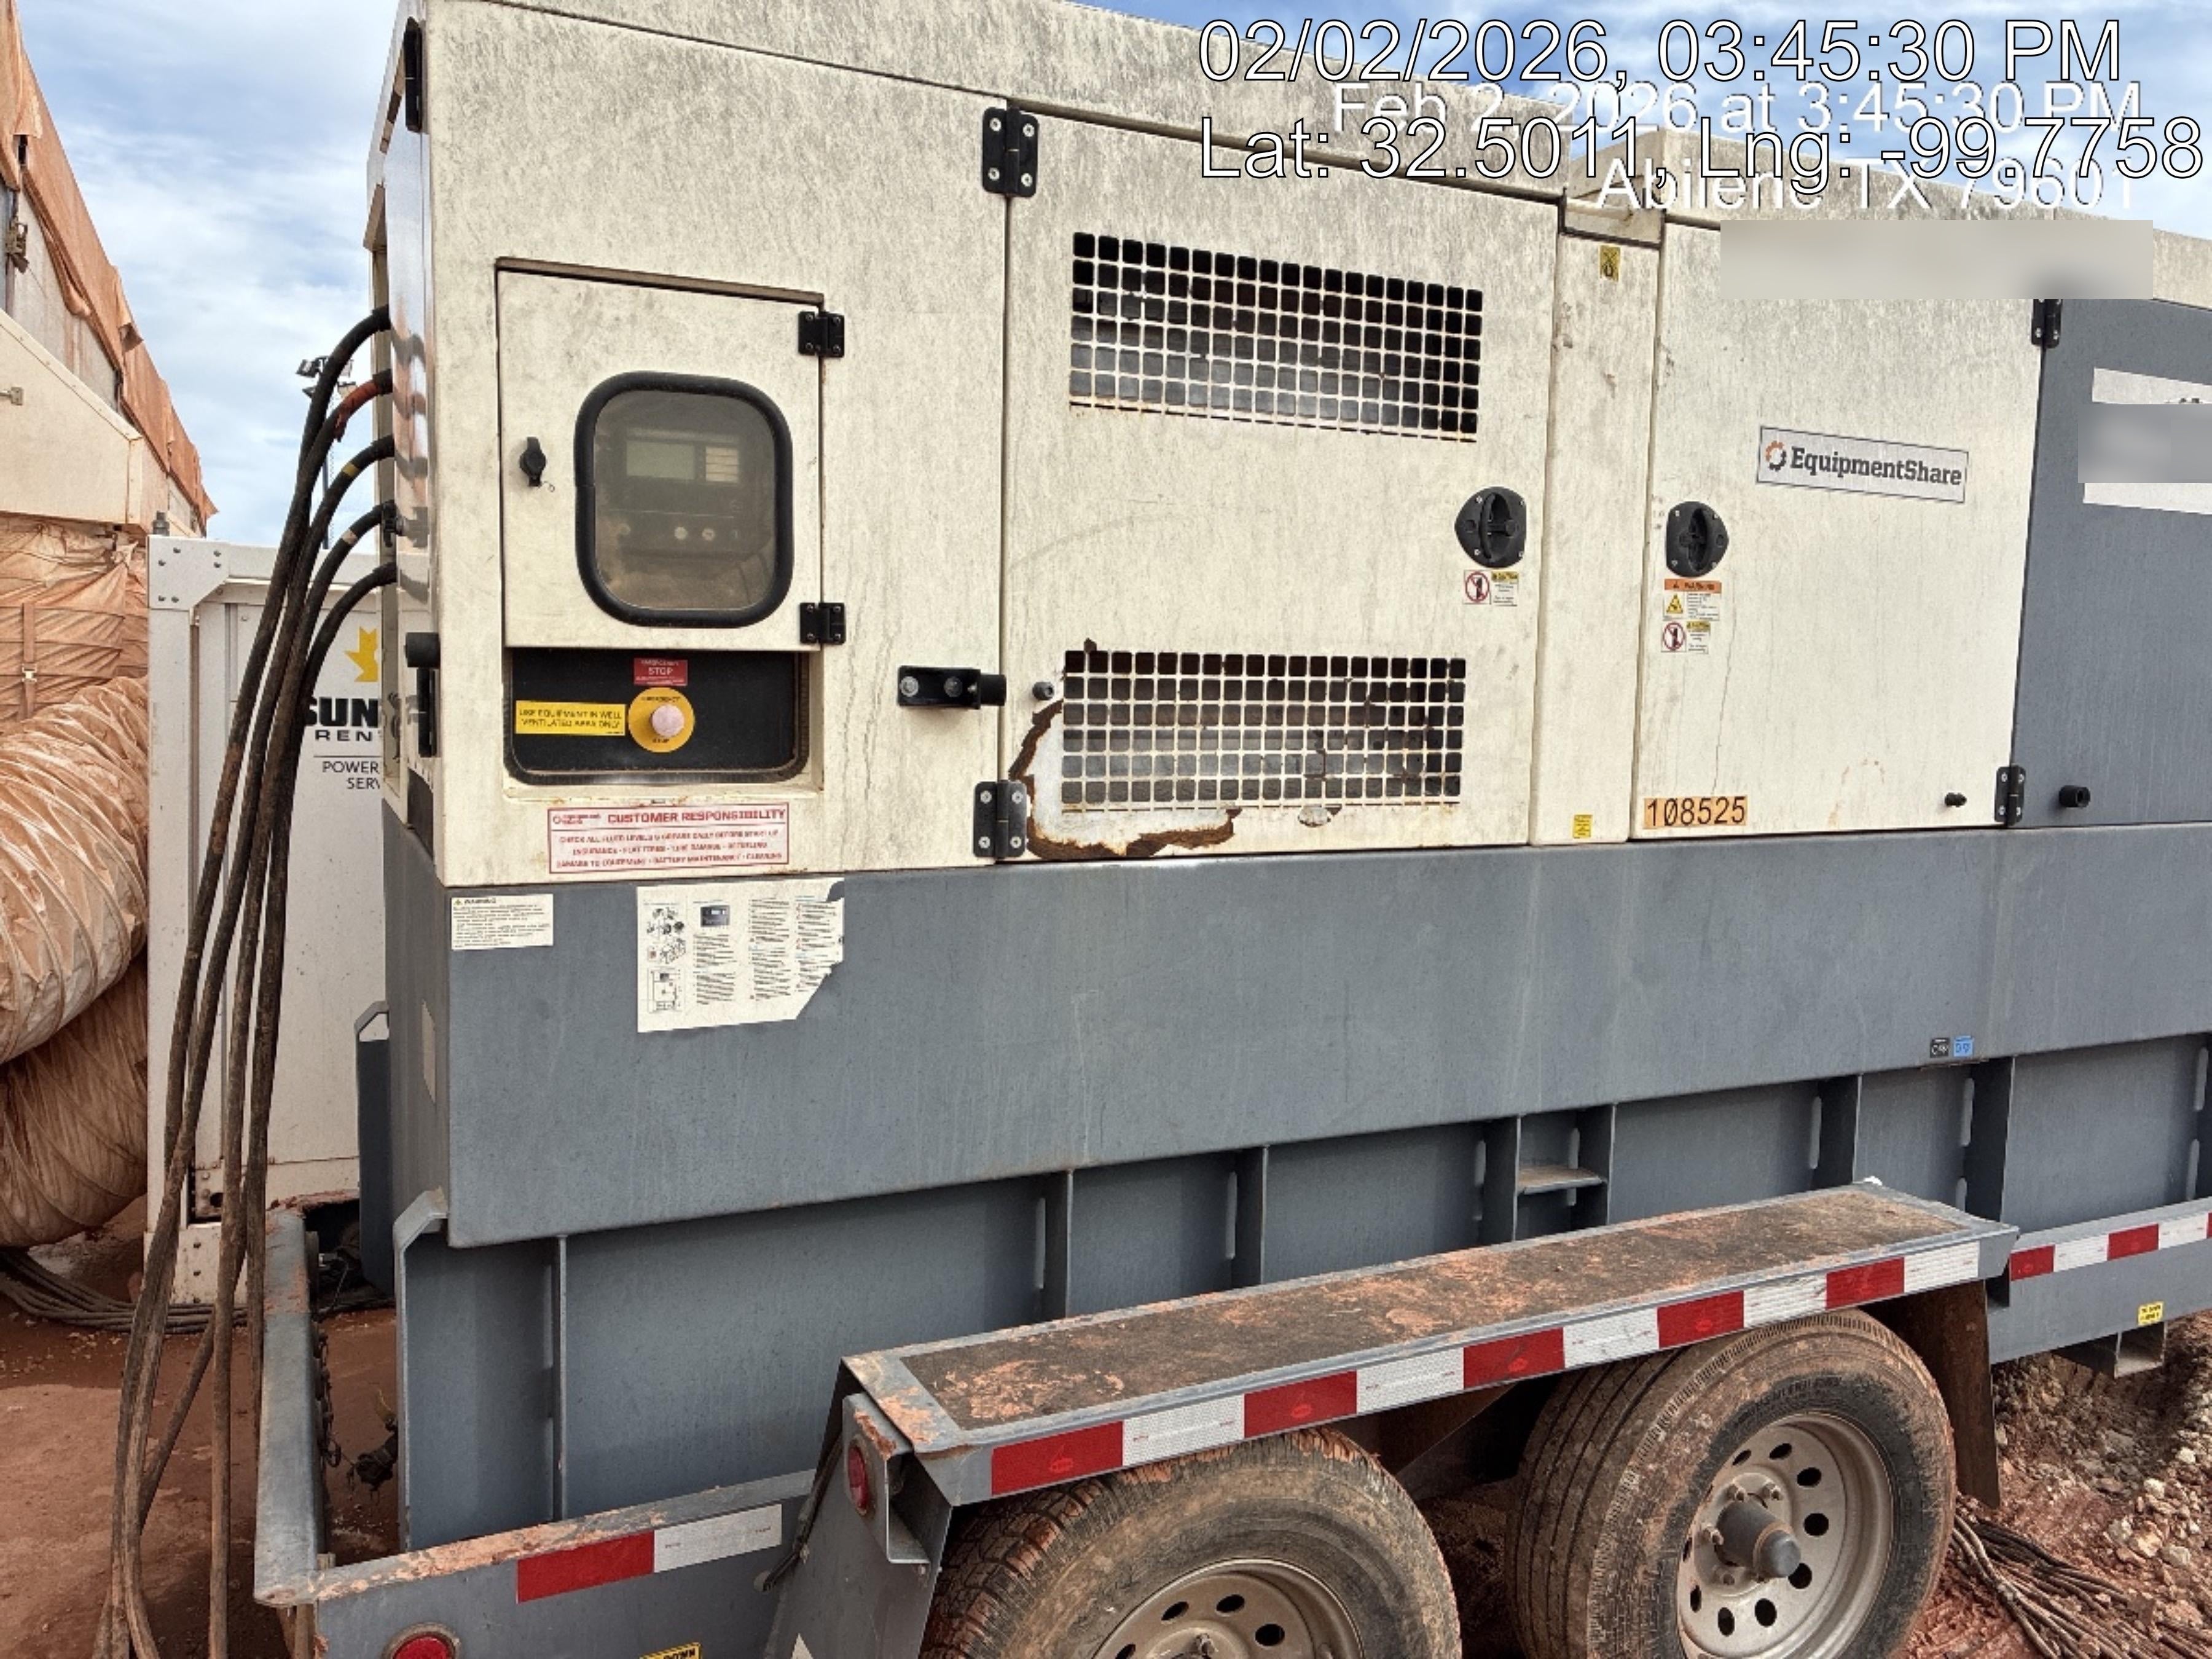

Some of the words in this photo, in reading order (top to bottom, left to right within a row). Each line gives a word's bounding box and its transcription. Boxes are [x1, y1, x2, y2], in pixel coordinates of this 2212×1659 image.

[1790, 446, 1962, 485] EquipmentShare
[648, 667, 673, 675] STOP
[599, 711, 622, 720] WELL
[323, 761, 380, 774] POWER
[608, 812, 679, 824] CUSTOMER
[681, 809, 786, 821] RESPONSIBILITY
[1647, 796, 1746, 826] 108525
